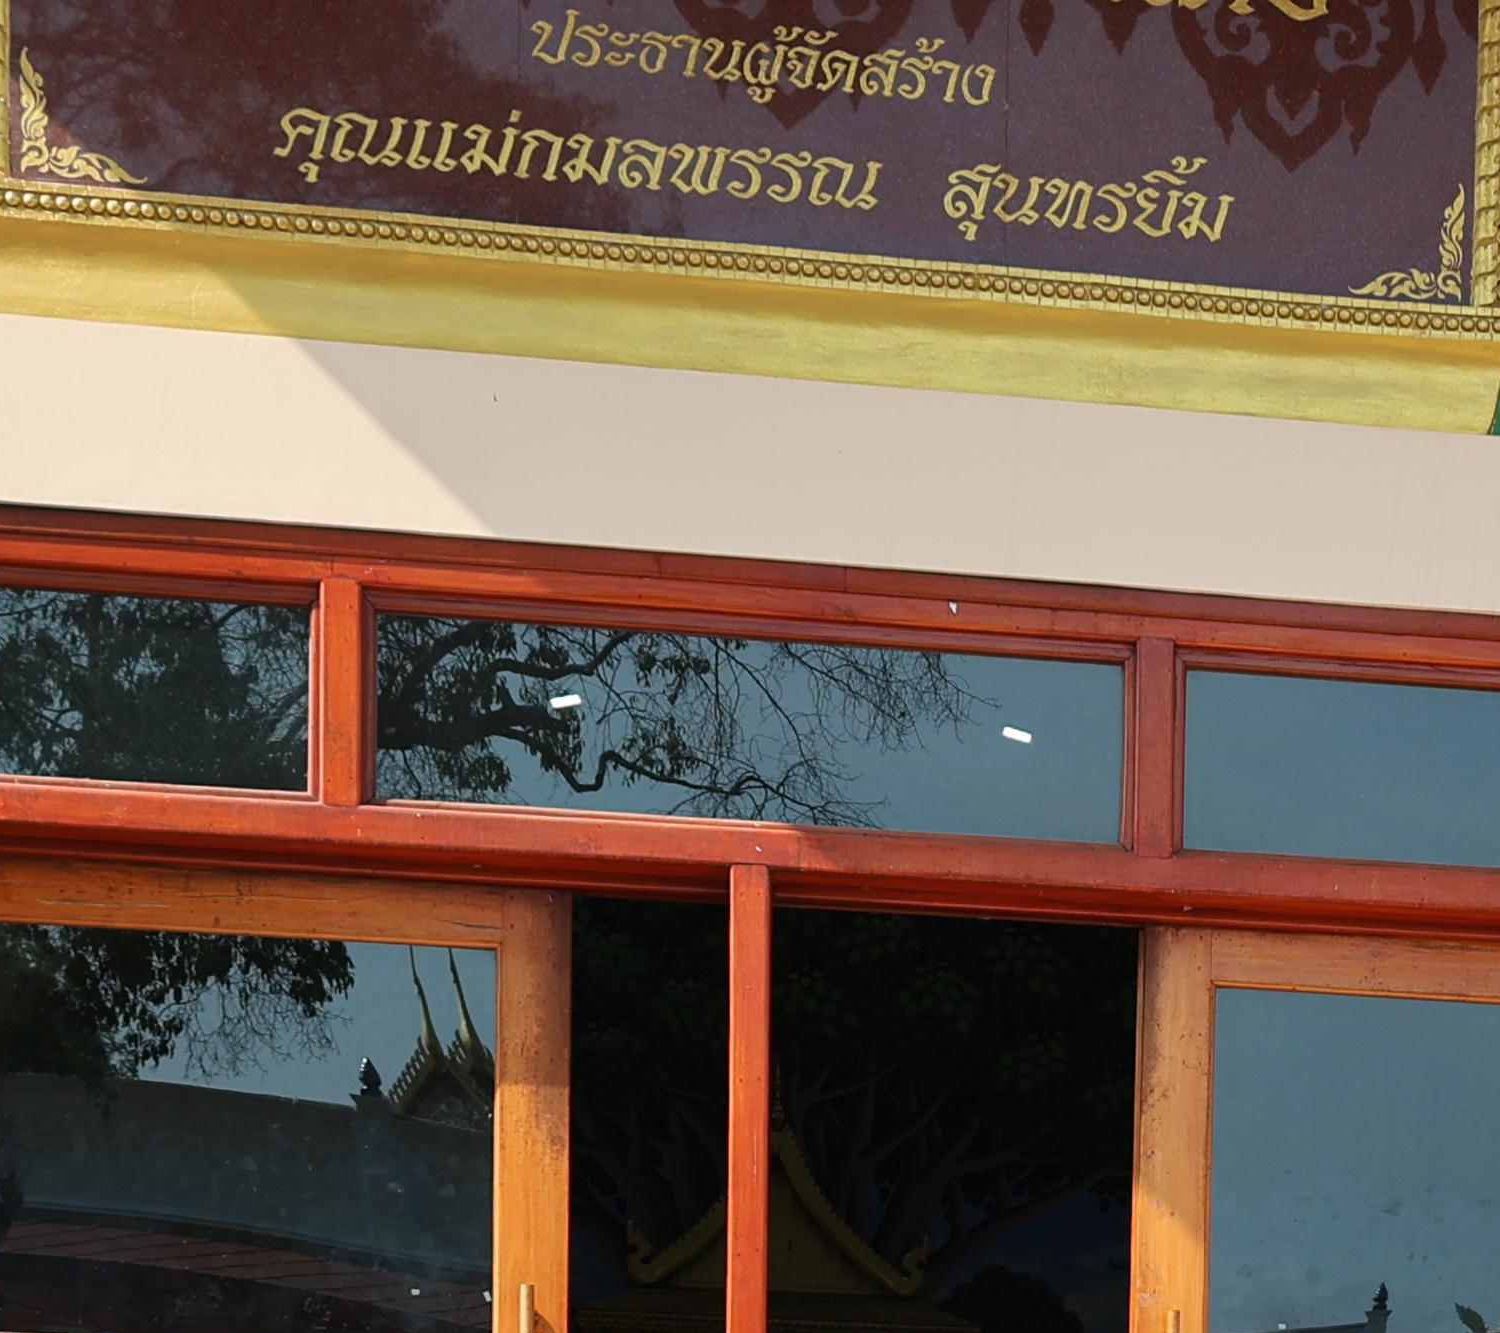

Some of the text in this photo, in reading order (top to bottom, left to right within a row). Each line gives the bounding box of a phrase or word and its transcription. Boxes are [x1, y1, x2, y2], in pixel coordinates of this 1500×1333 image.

[531, 8, 997, 104] ประธานผู้จัดสร้าง
[274, 107, 1233, 242] คุณแม่กมลพรรณ สุนทรยิ้ม
